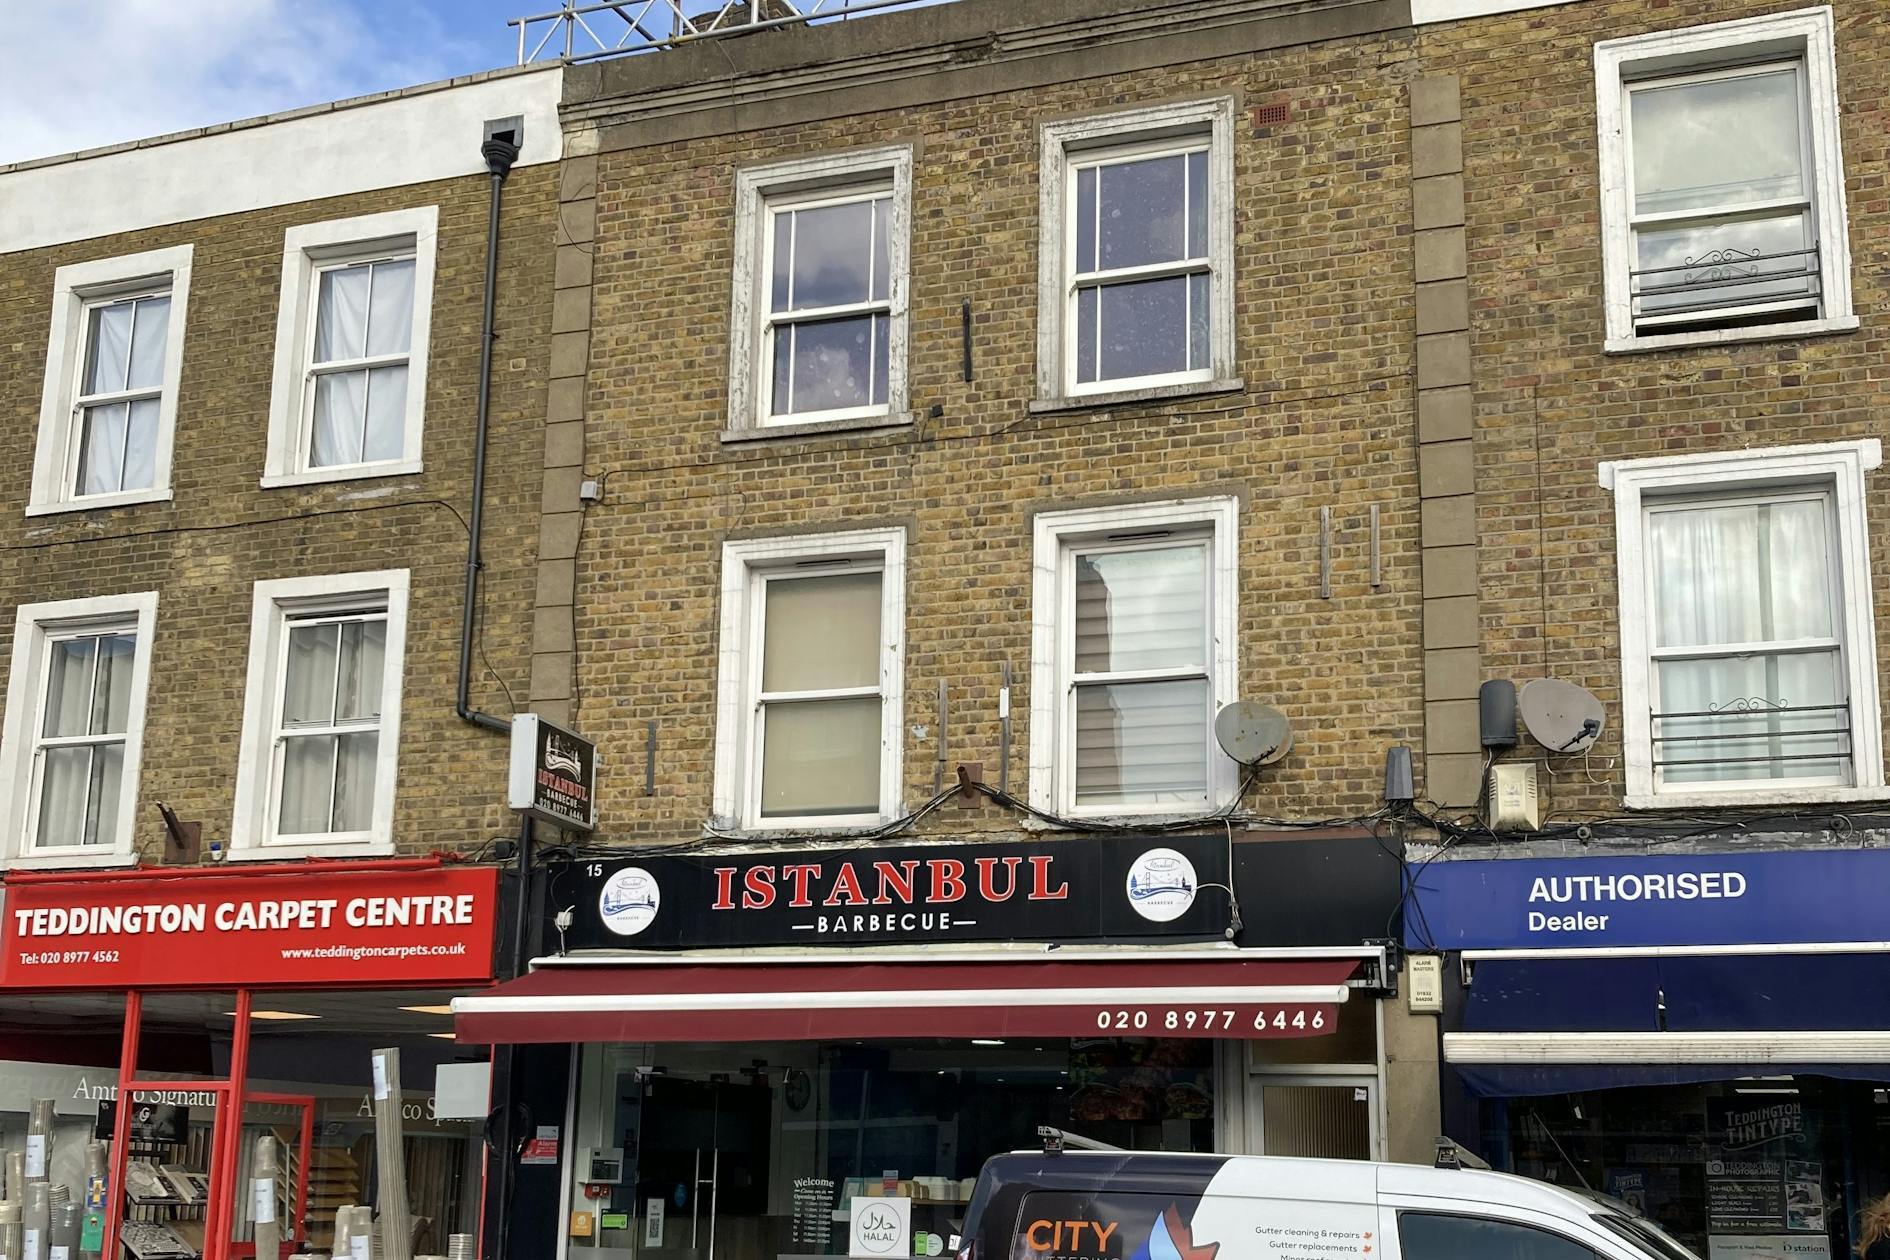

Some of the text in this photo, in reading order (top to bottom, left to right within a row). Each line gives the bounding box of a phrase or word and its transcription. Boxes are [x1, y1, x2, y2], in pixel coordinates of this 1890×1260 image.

[537, 768, 589, 801] ISTANBUL
[546, 788, 578, 808] BARBECUE
[586, 864, 603, 878] 15
[712, 856, 1069, 910] ISTANBUL
[1528, 872, 1747, 903] AUTHORISED
[15, 894, 474, 937] TEDDINGTON CARPET CENTRE
[817, 913, 950, 934] BARBECUE
[1528, 911, 1609, 932] Dealer
[20, 950, 120, 965] Tel: 020 8977 4562
[281, 942, 466, 960] www.teddingtoncarpets.co.uk
[1097, 1010, 1325, 1030] 020 8977 6446
[72, 1077, 216, 1107] Amto Signatu
[1724, 1102, 1802, 1127] TEDDINGTON
[1726, 1115, 1803, 1145] TINTYPE
[1725, 1168, 1780, 1176] PHOTOGRAPHIC
[793, 1177, 835, 1188] Welcome
[863, 1232, 894, 1241] HALAL
[1026, 1219, 1119, 1252] CITY
[1255, 1226, 1282, 1235] Gutter
[1284, 1228, 1319, 1239] cleaning
[1328, 1230, 1360, 1240] repairs
[1269, 1240, 1358, 1253] Gutter replacements
[1793, 1244, 1825, 1252] station
